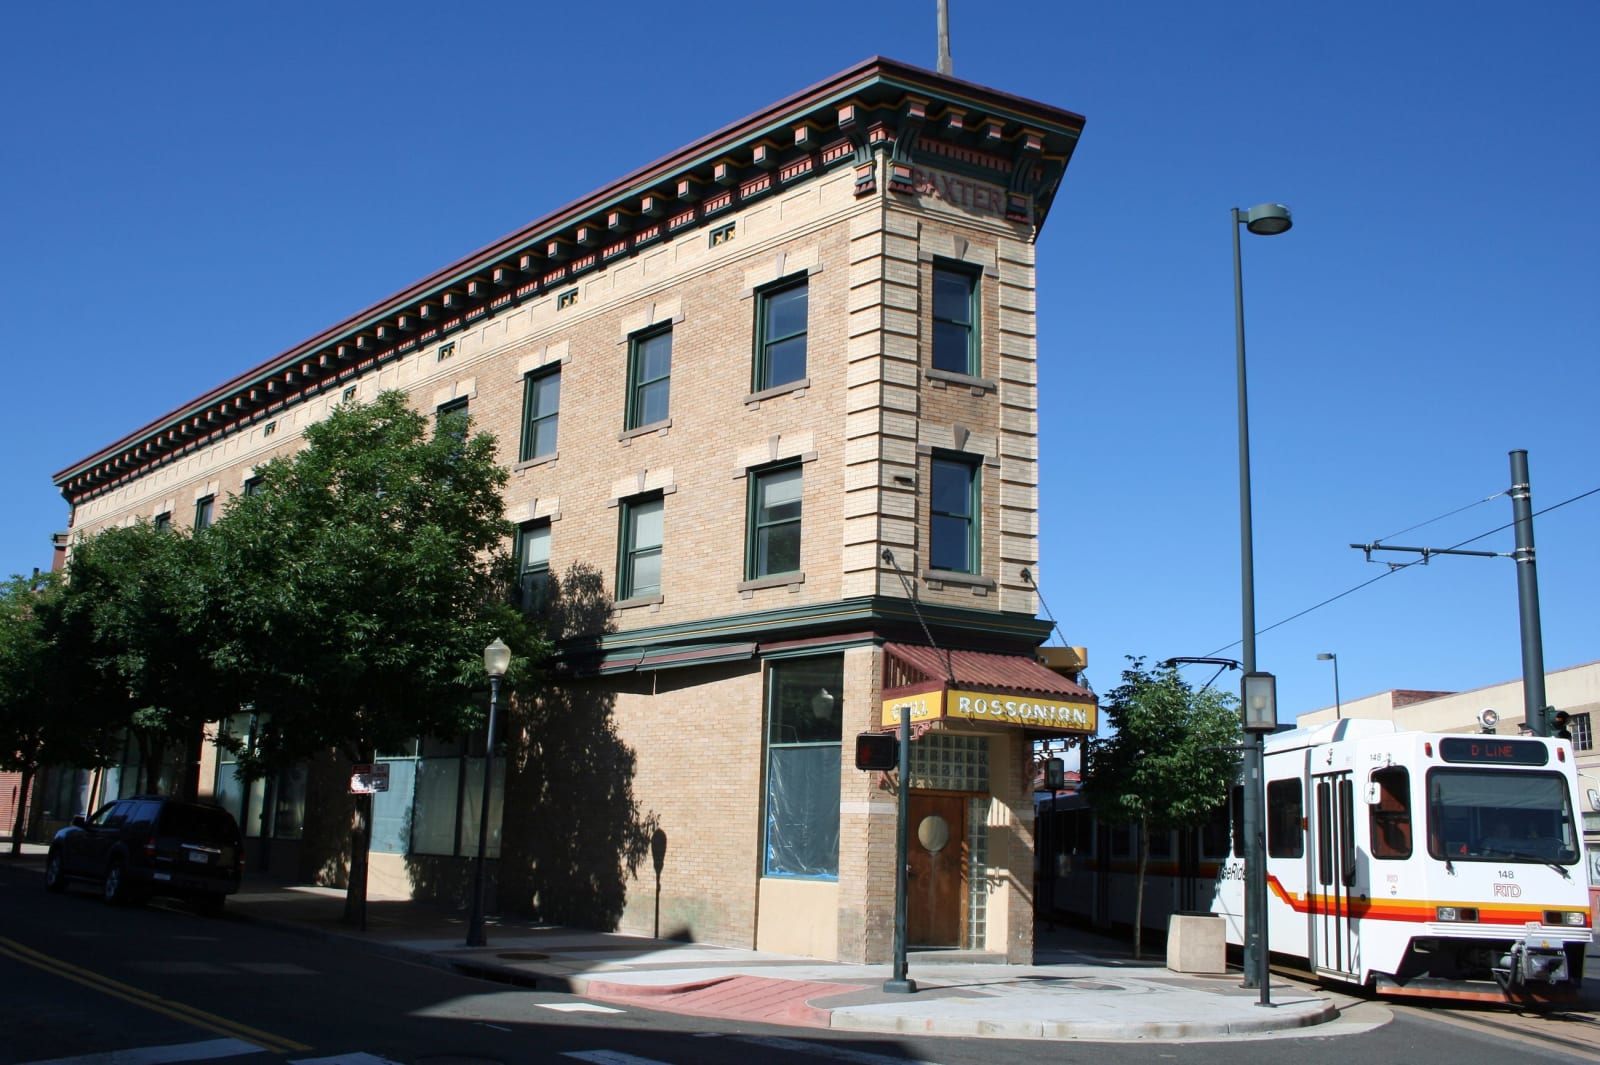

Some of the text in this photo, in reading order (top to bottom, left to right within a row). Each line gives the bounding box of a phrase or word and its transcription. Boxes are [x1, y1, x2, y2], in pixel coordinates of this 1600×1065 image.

[912, 168, 1003, 214] BAXTER
[891, 699, 928, 721] GILL
[959, 696, 1087, 724] ROSSONIAN
[1471, 744, 1512, 757] D LINE
[1498, 870, 1514, 879] 148
[1493, 883, 1521, 897] RTD
